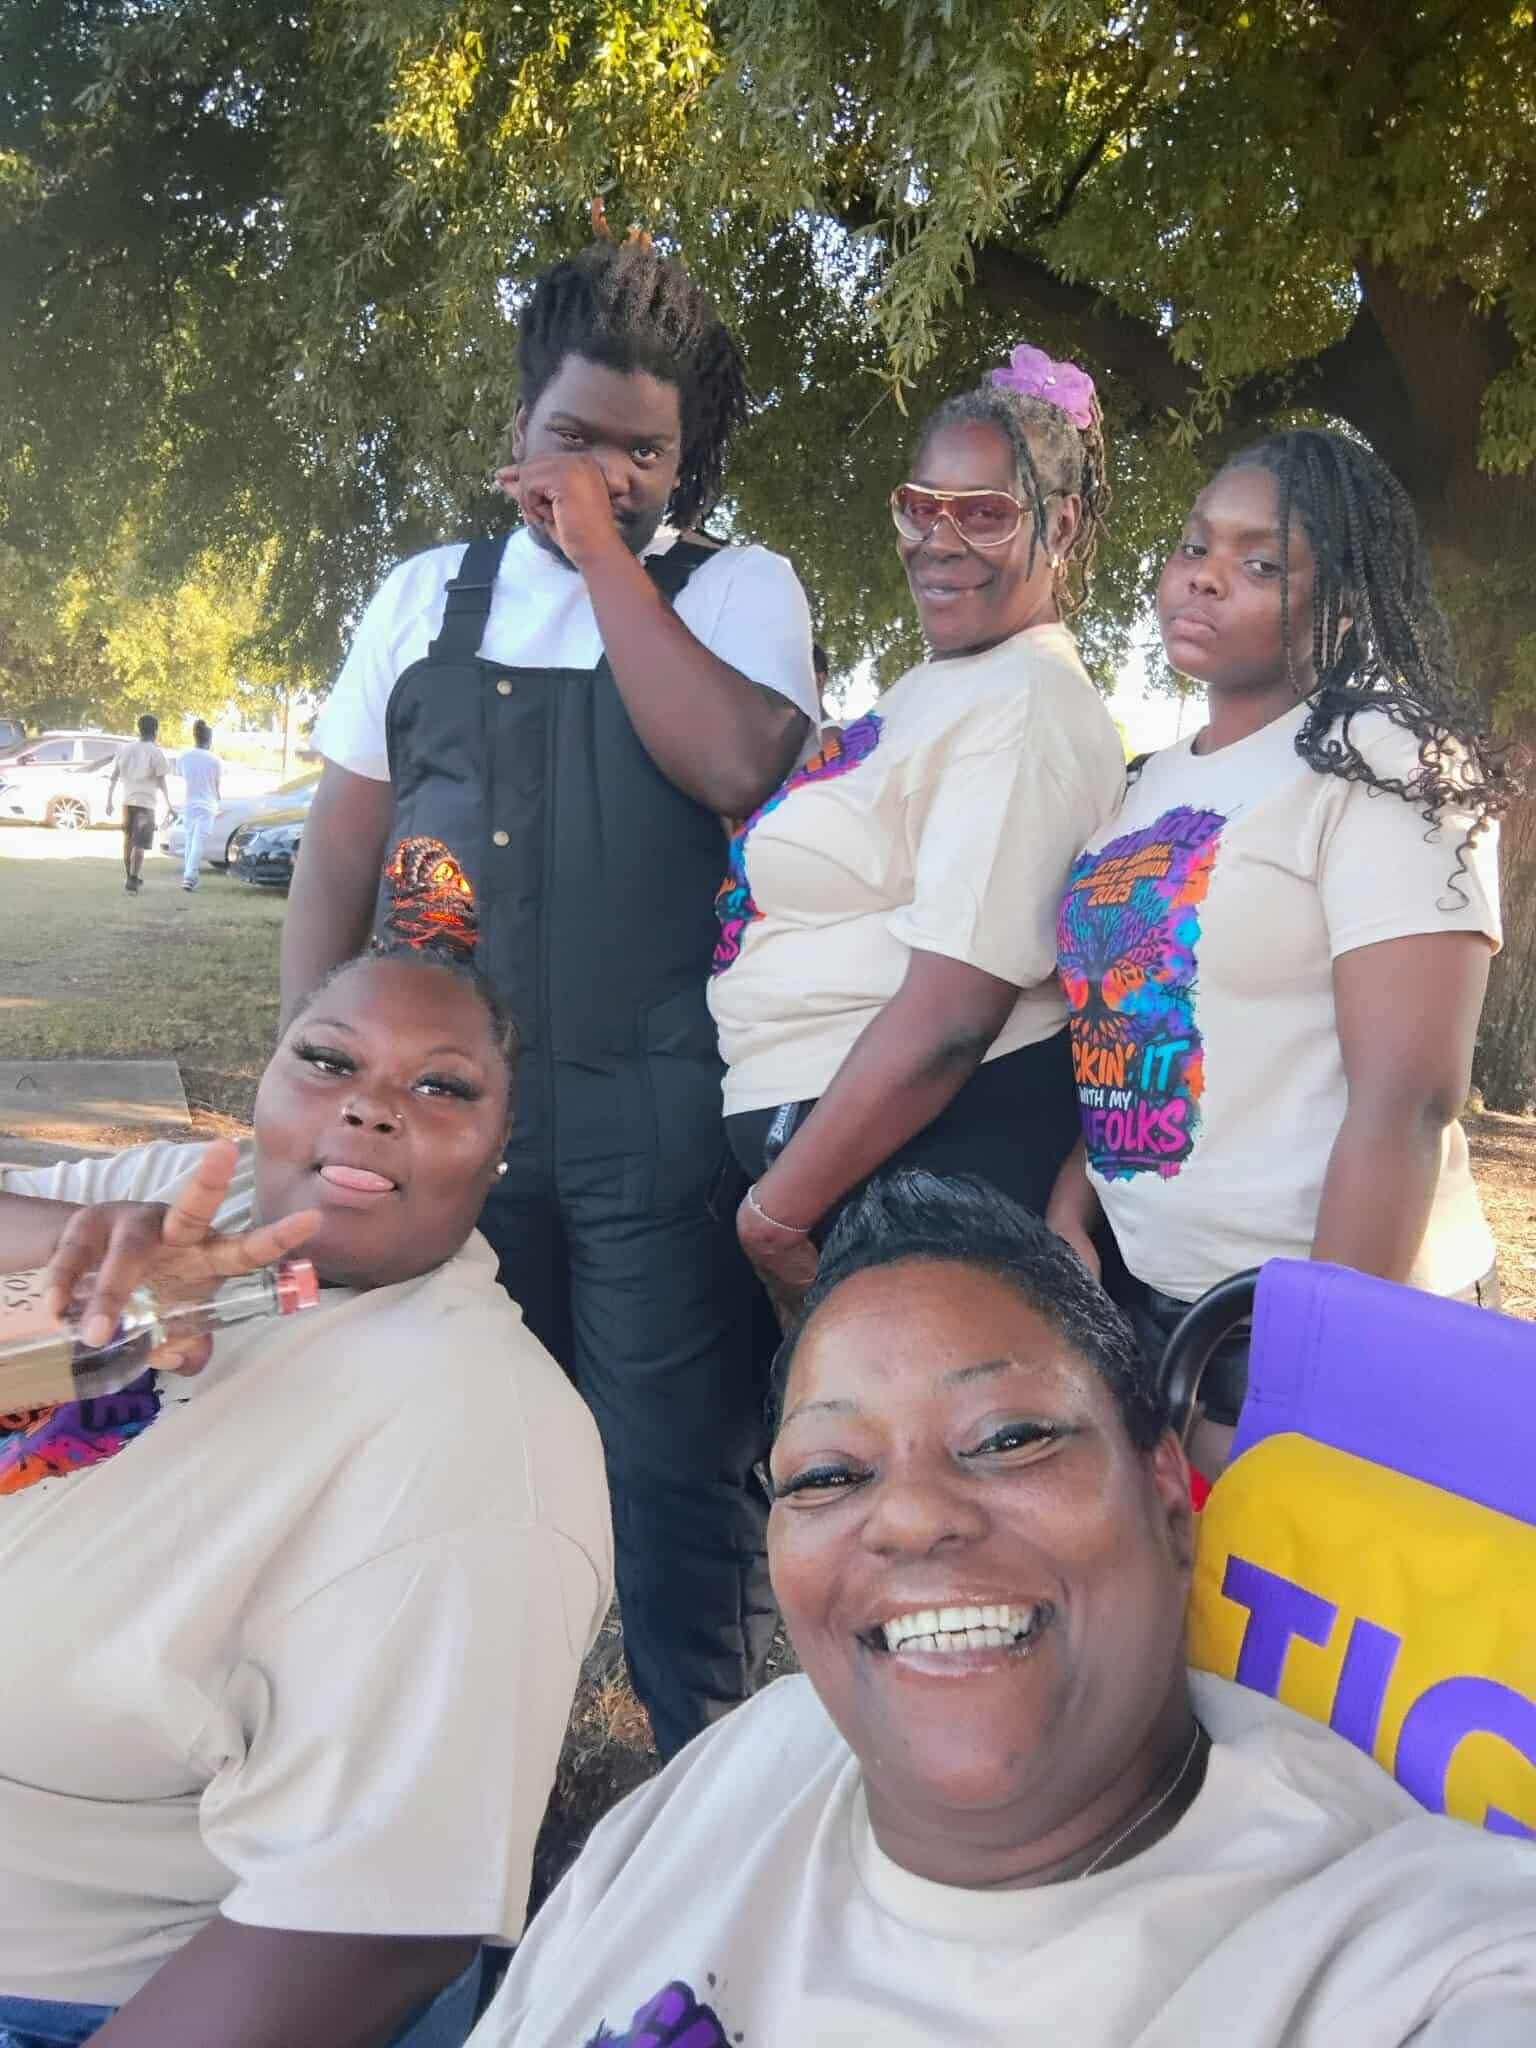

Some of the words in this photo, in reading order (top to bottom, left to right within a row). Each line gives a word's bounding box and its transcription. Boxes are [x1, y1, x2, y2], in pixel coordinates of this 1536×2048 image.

[1088, 880, 1136, 906] 2025
[1140, 1040, 1190, 1091] IT
[1109, 1089, 1132, 1112] MY
